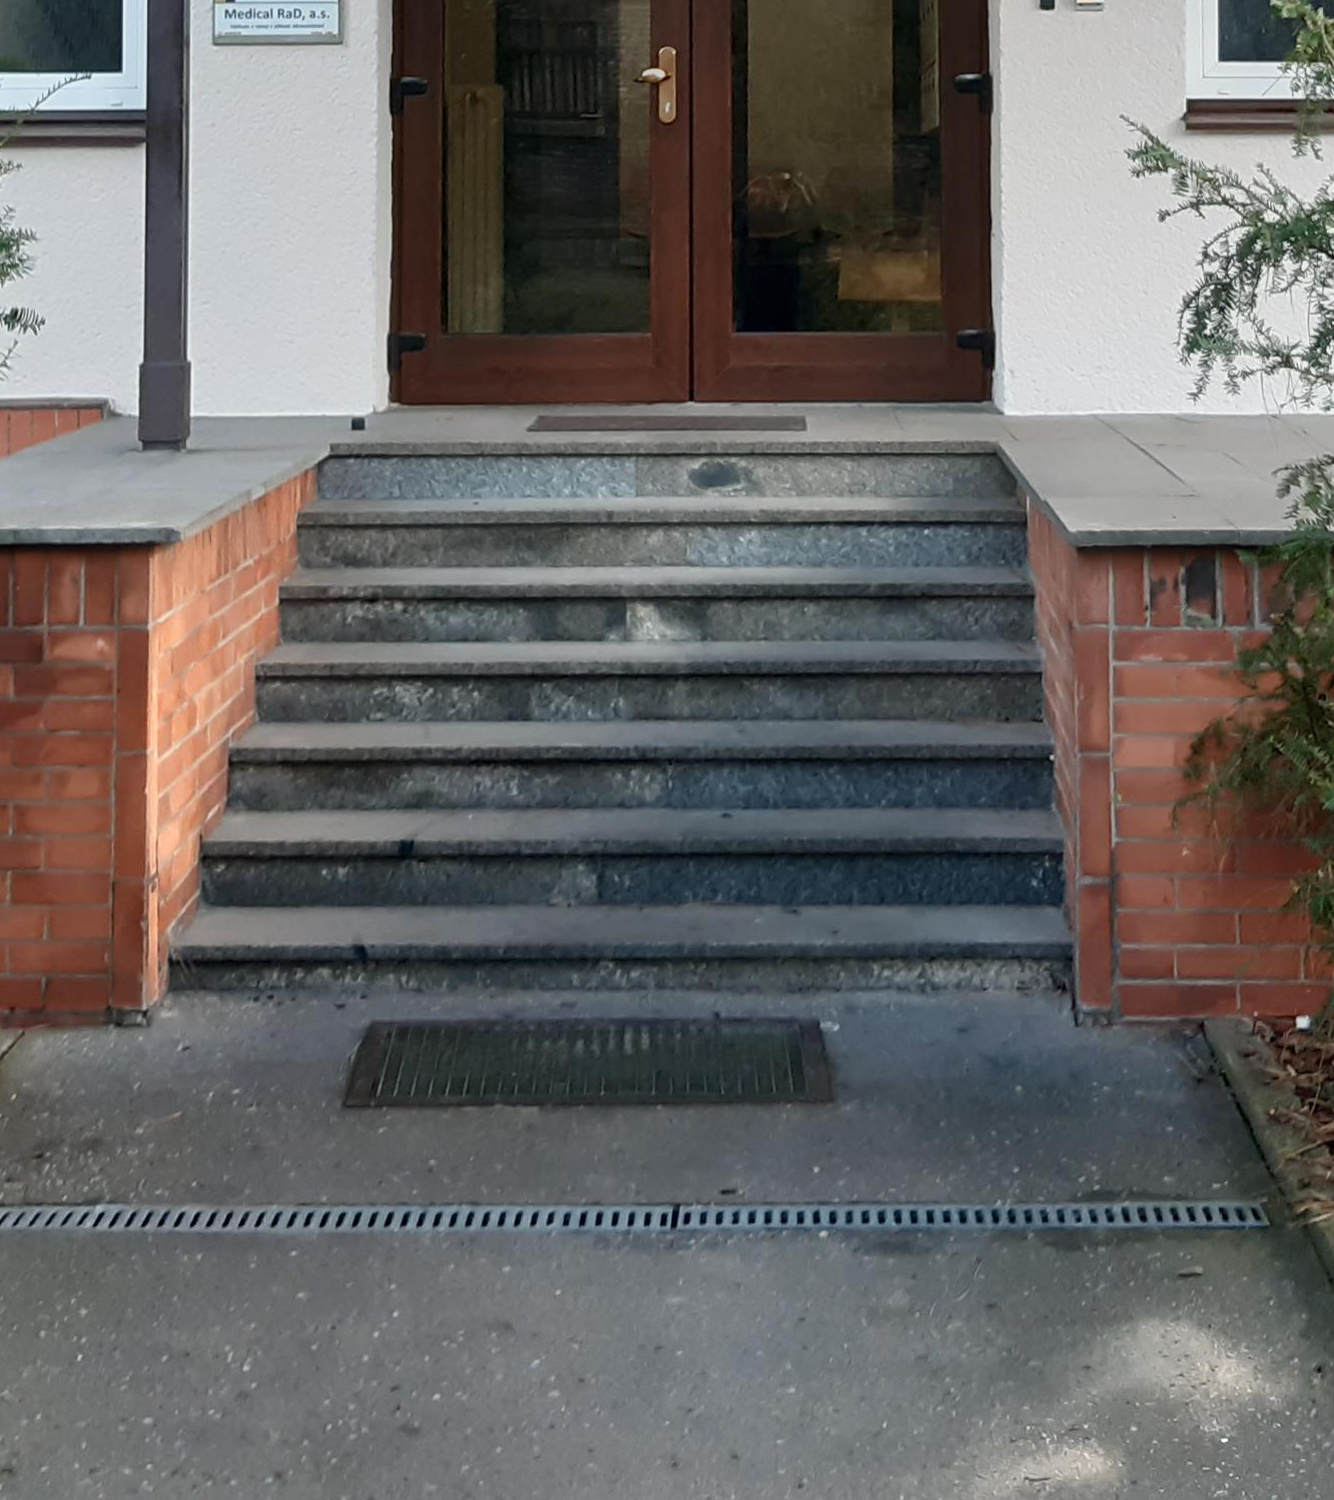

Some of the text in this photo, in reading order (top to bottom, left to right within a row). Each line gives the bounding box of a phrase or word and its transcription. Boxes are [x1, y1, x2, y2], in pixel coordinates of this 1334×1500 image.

[224, 7, 331, 21] Medical RaD, a.s.
